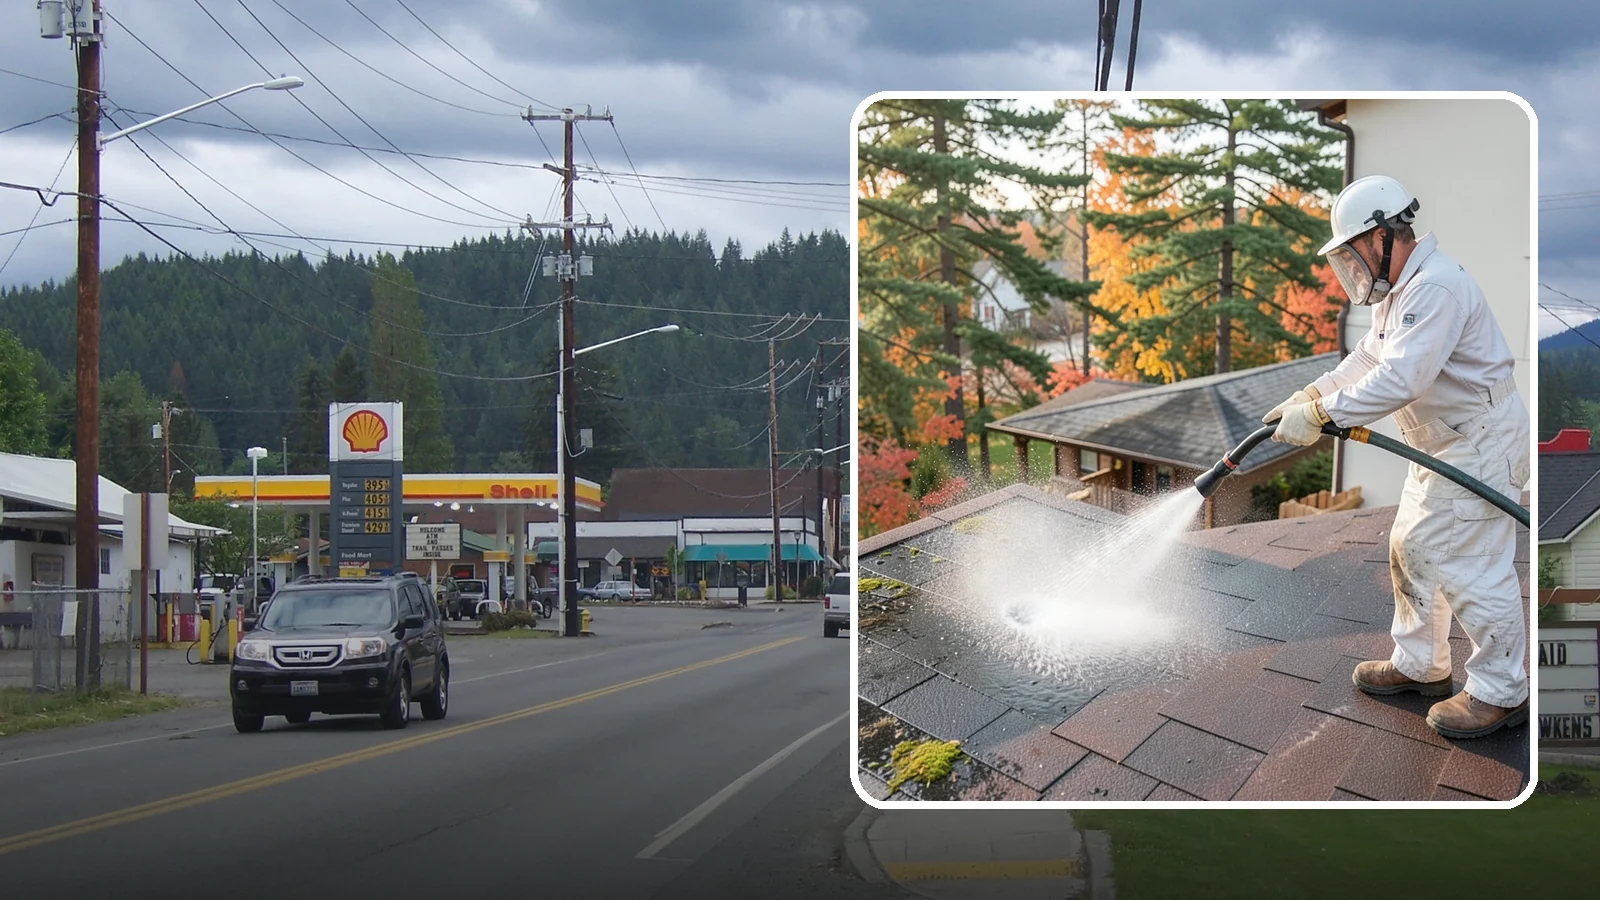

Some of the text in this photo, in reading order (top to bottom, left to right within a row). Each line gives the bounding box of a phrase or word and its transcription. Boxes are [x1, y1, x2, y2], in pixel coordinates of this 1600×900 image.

[366, 480, 383, 490] 395
[490, 484, 547, 499] Shell
[366, 494, 383, 504] 405
[366, 508, 383, 518] 415
[366, 523, 383, 532] 429
